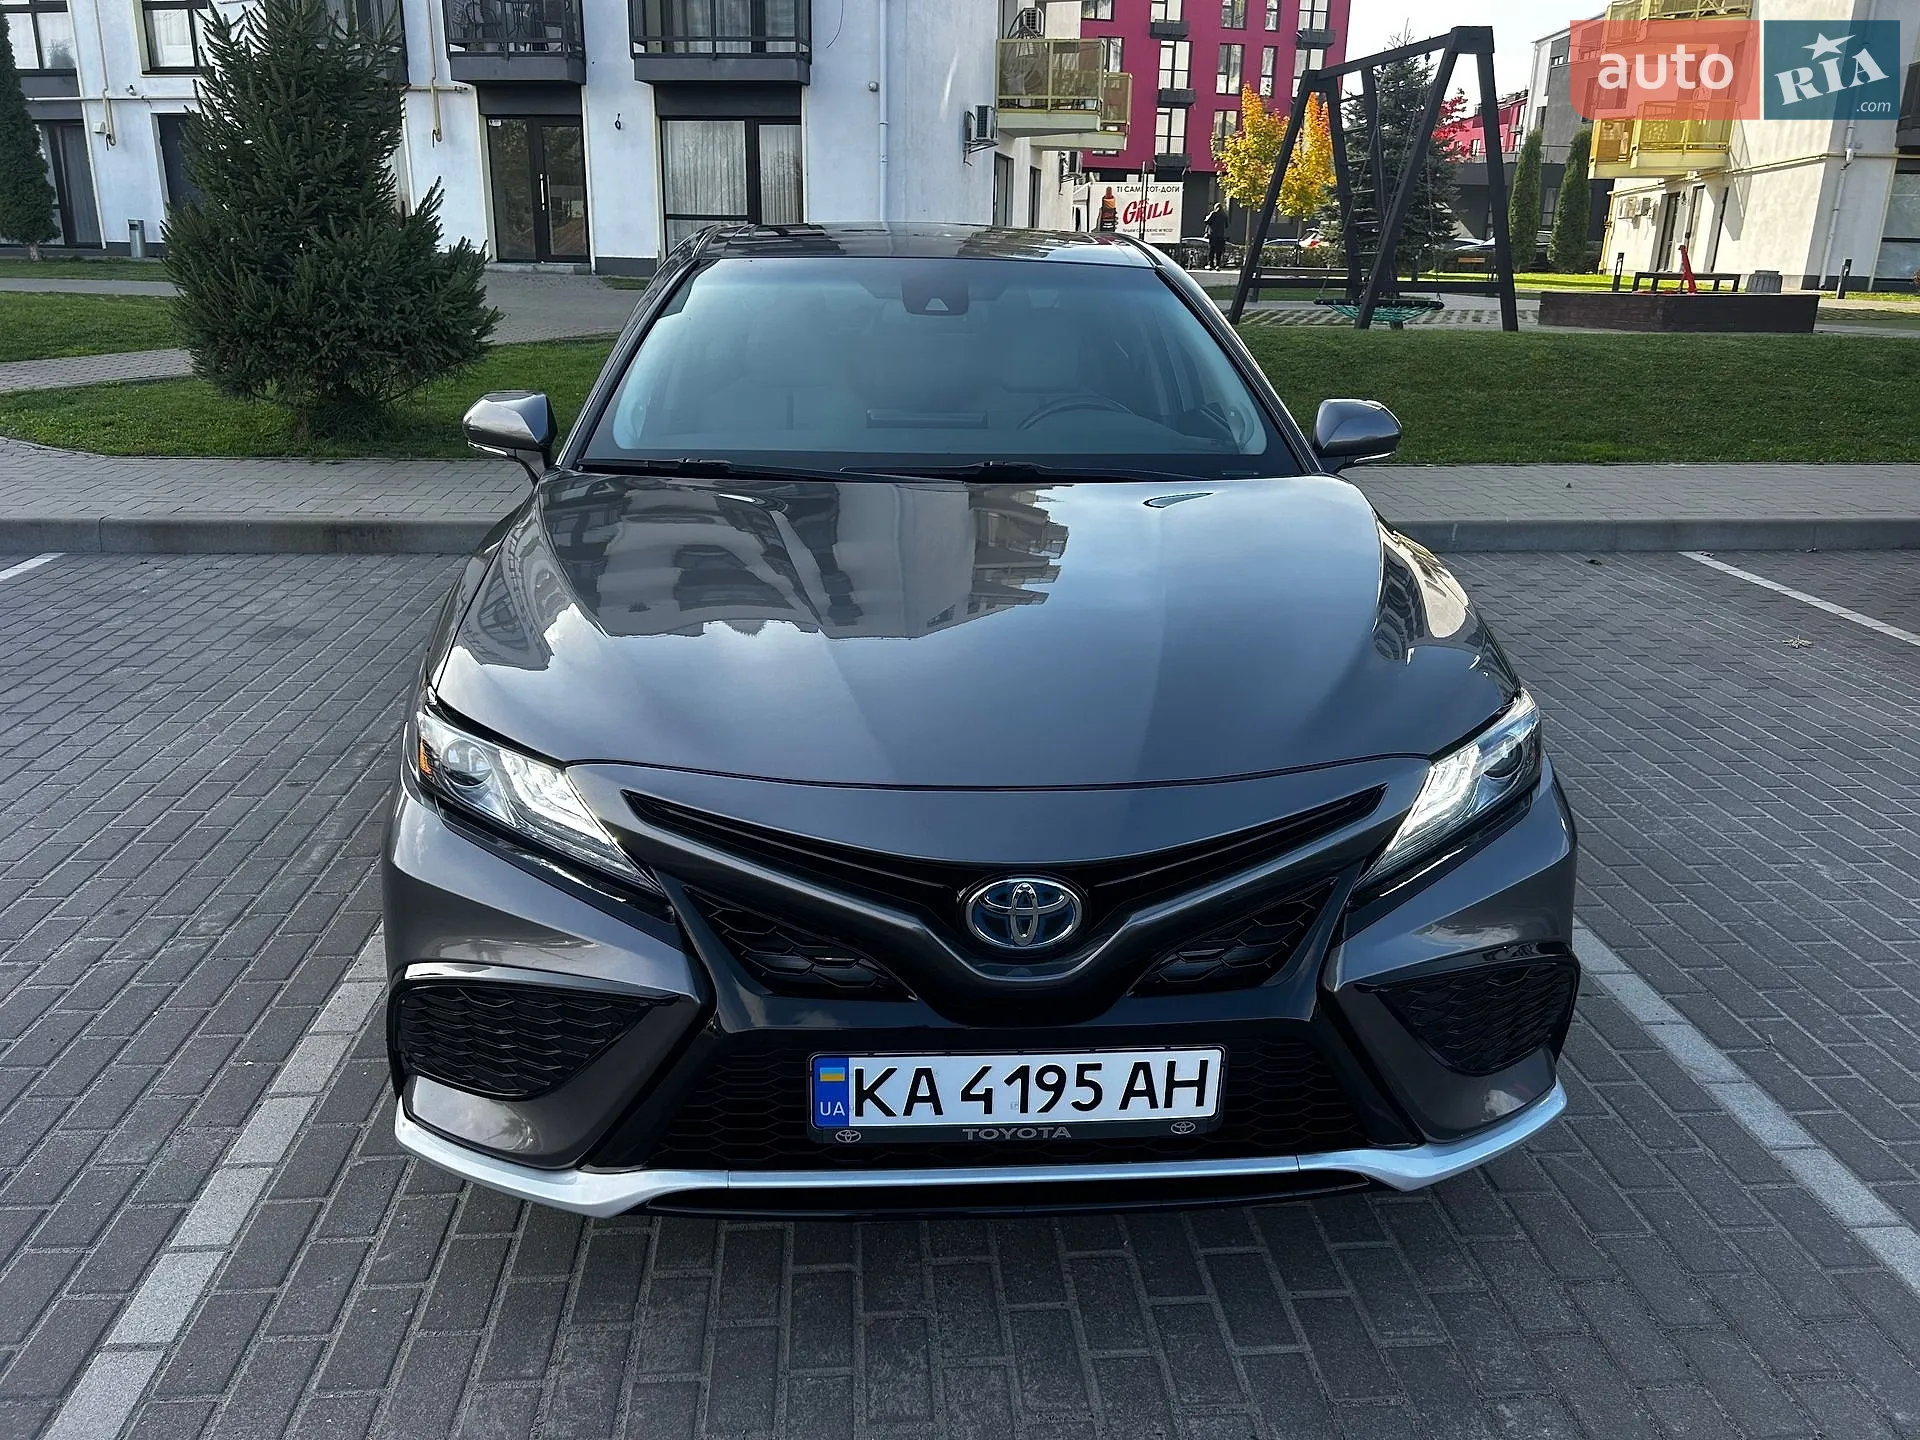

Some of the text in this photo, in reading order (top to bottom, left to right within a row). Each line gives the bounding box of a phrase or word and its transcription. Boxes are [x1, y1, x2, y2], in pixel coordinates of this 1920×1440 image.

[1122, 200, 1174, 225] GRILL
[853, 1059, 1209, 1118] KA 4195 AH
[820, 1102, 846, 1116] UA
[962, 1126, 1072, 1141] TOYOTA
